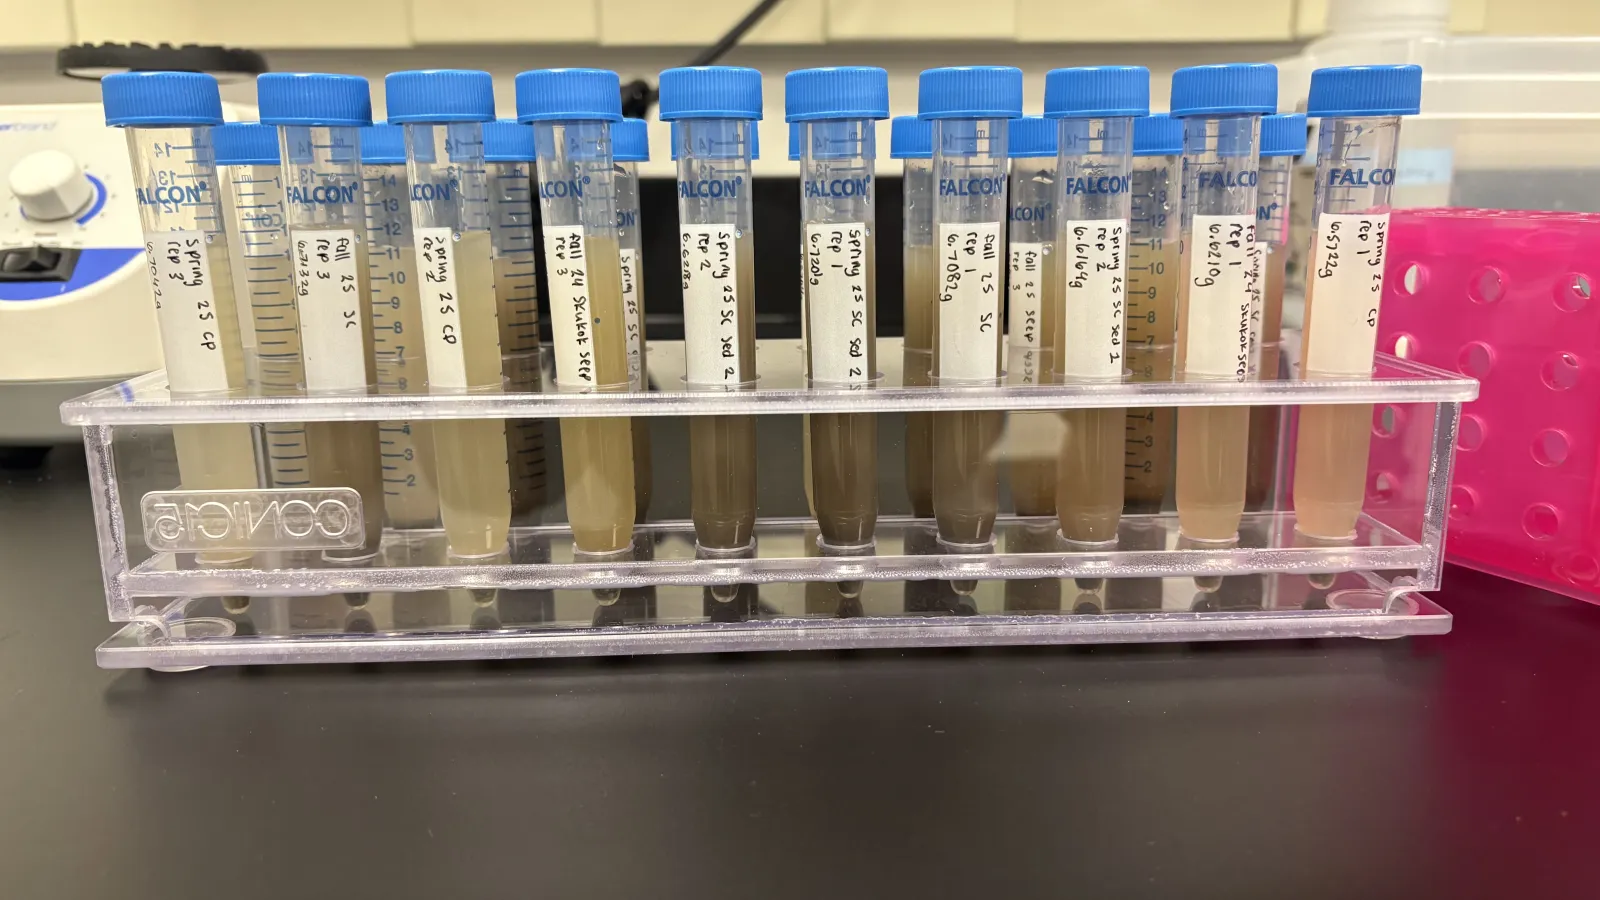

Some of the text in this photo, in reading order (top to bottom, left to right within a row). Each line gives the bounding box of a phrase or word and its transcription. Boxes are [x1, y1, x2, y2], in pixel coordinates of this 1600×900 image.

[380, 173, 397, 187] 14
[1198, 170, 1257, 189] FALCO
[1329, 167, 1396, 186] FALCO
[135, 181, 207, 205] ALCON
[286, 182, 358, 204] FALCON
[680, 176, 742, 198] ALCON
[381, 197, 399, 212] 13
[1152, 190, 1167, 203] 13
[383, 222, 402, 236] 12
[1151, 214, 1167, 227] 12
[1226, 223, 1243, 249] rep
[1357, 220, 1372, 242] rep
[335, 237, 351, 262] fall
[569, 232, 583, 260] fall
[826, 231, 843, 253] rep
[963, 231, 978, 256] rep
[1095, 227, 1107, 272] rep 2
[1149, 238, 1162, 251] 11
[167, 241, 181, 264] rep
[316, 239, 331, 280] rep 3
[386, 246, 400, 261] 11
[555, 236, 568, 276] rep 3
[697, 232, 711, 271] rep 2
[168, 272, 185, 281] 3
[425, 270, 435, 282] 2
[571, 268, 585, 287] 24
[1149, 262, 1164, 275] 10
[341, 274, 355, 293] 25
[388, 271, 406, 285] 10
[980, 233, 996, 332] fall 25 SC
[1112, 276, 1122, 294] 25
[1371, 273, 1382, 292] 25
[723, 284, 735, 303] 25
[851, 285, 863, 303] 25
[1025, 281, 1036, 299] 25
[1147, 286, 1156, 300] 9
[197, 300, 214, 320] 25
[390, 296, 400, 310] 9
[439, 292, 455, 314] 25
[720, 309, 734, 326] SC
[851, 310, 863, 327] SC
[1147, 311, 1156, 323] 8
[393, 321, 403, 334] 8
[442, 324, 457, 345] CP
[200, 331, 217, 351] CP
[1146, 335, 1155, 345] 7
[395, 345, 405, 359] 7
[724, 366, 735, 380] 2
[1145, 411, 1154, 423] 4
[1144, 435, 1153, 448] 3
[404, 448, 414, 461] 3
[1144, 460, 1152, 473] 2
[406, 474, 416, 487] 2
